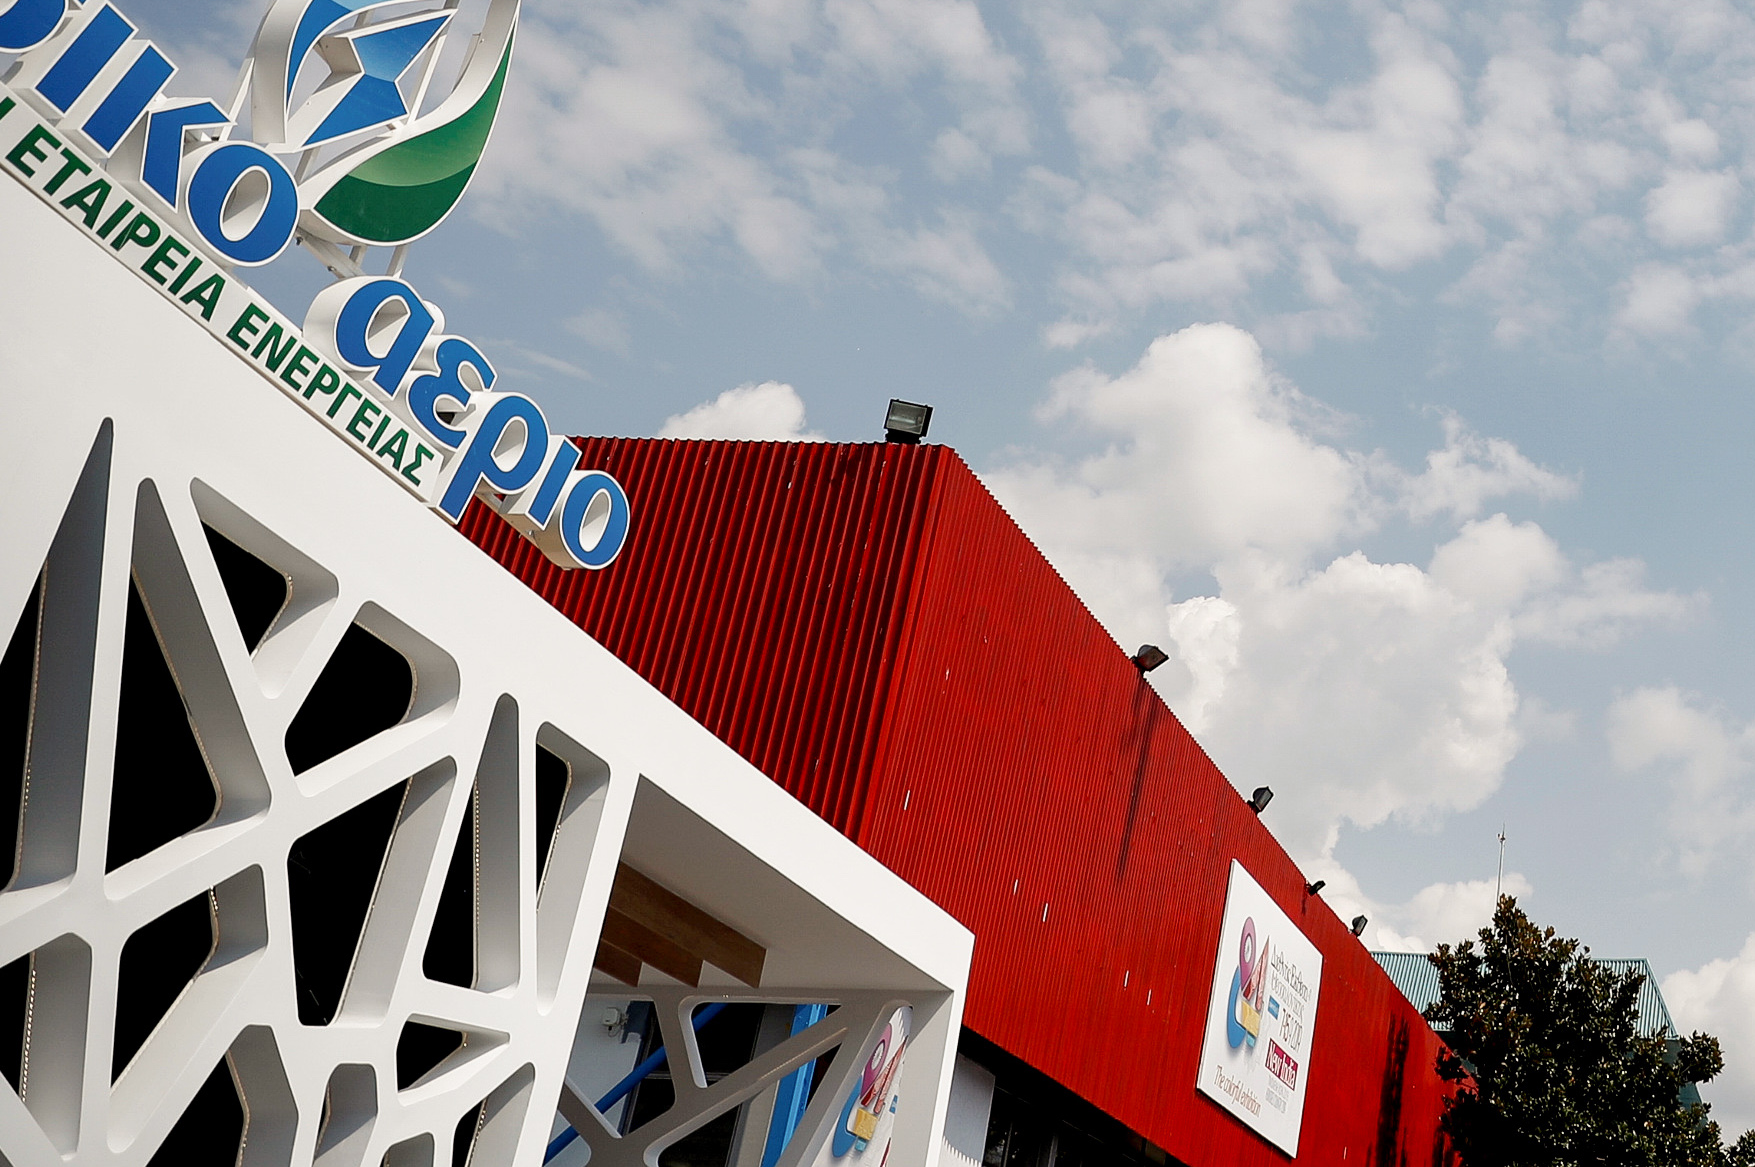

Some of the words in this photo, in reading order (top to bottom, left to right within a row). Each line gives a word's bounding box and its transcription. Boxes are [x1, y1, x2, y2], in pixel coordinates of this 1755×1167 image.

[4, 122, 226, 322] ΕΤΑΙΡΕΙΑ
[225, 302, 436, 487] ΕΝΕΡΓΕΙΑΣ
[334, 276, 630, 570] αεριο
[1214, 1065, 1223, 1089] The
[1267, 1043, 1282, 1075] New
